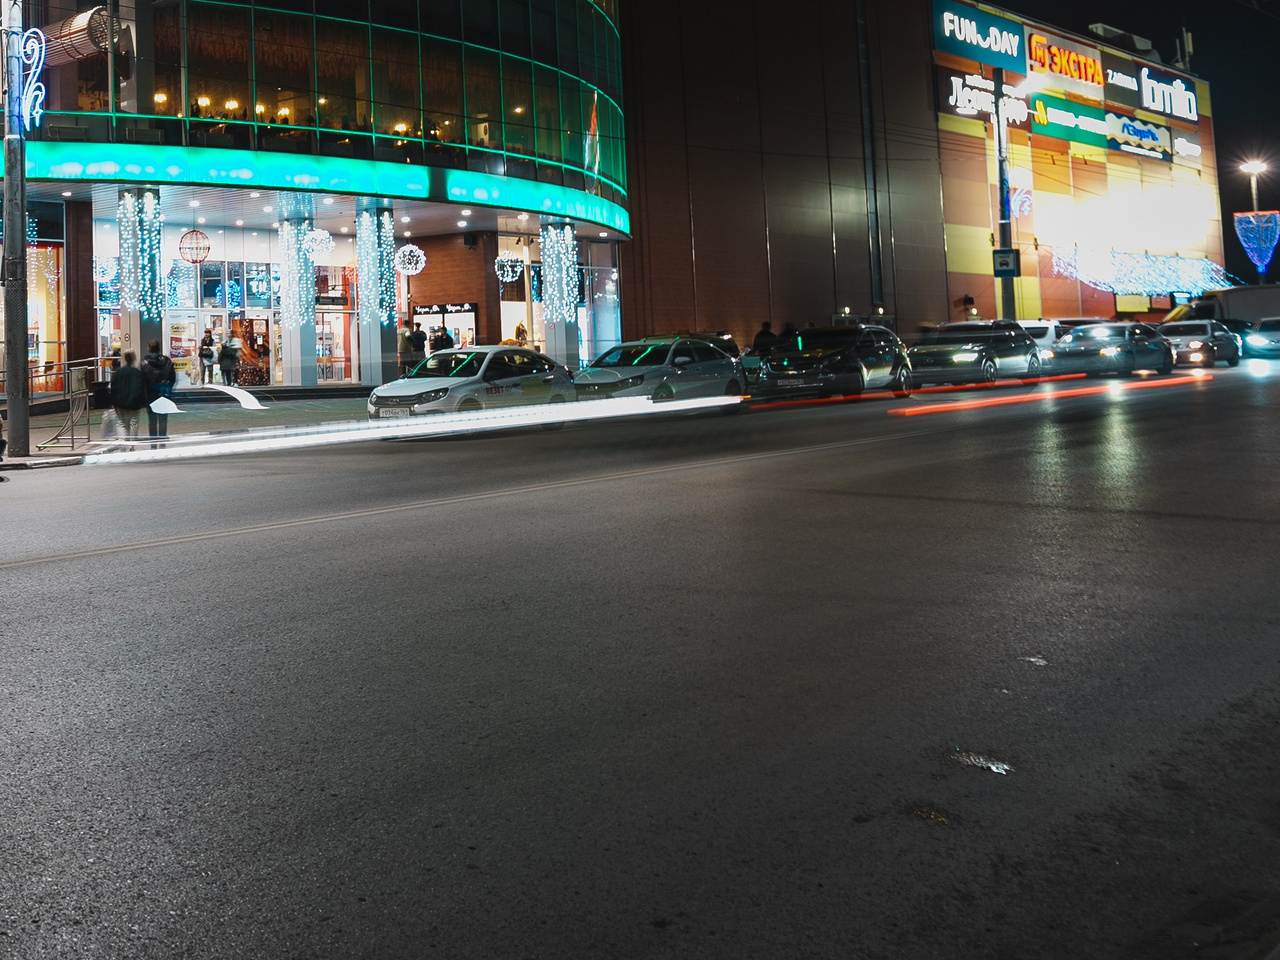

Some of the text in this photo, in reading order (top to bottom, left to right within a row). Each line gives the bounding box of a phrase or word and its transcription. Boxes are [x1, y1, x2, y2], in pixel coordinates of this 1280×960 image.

[943, 11, 1019, 57] FUN DAY
[1048, 45, 1106, 86] ЭКСТРА
